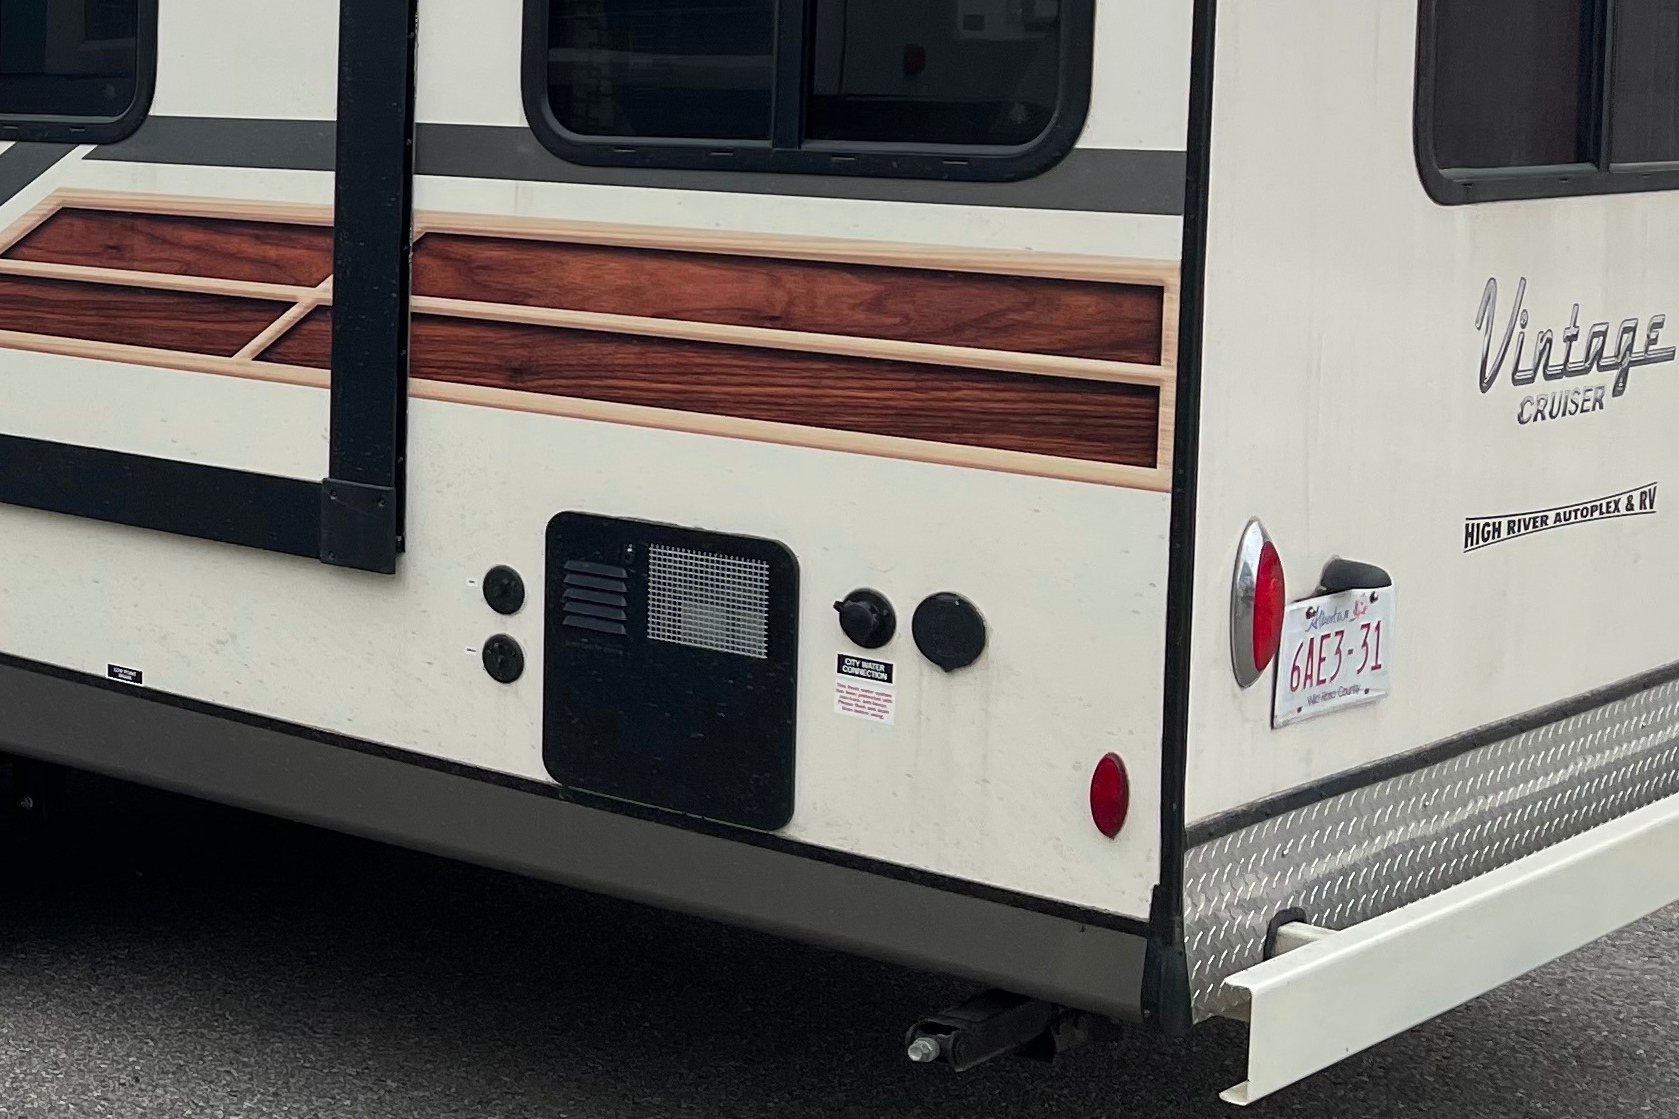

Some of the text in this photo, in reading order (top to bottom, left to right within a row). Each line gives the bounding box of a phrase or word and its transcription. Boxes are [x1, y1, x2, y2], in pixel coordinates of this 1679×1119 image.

[1474, 276, 1676, 398] Vintage
[1517, 385, 1605, 425] CRUISER
[1464, 486, 1657, 549] HIGH RIVER AUTOPLEX & RV
[1289, 620, 1382, 692] 6AE3-31
